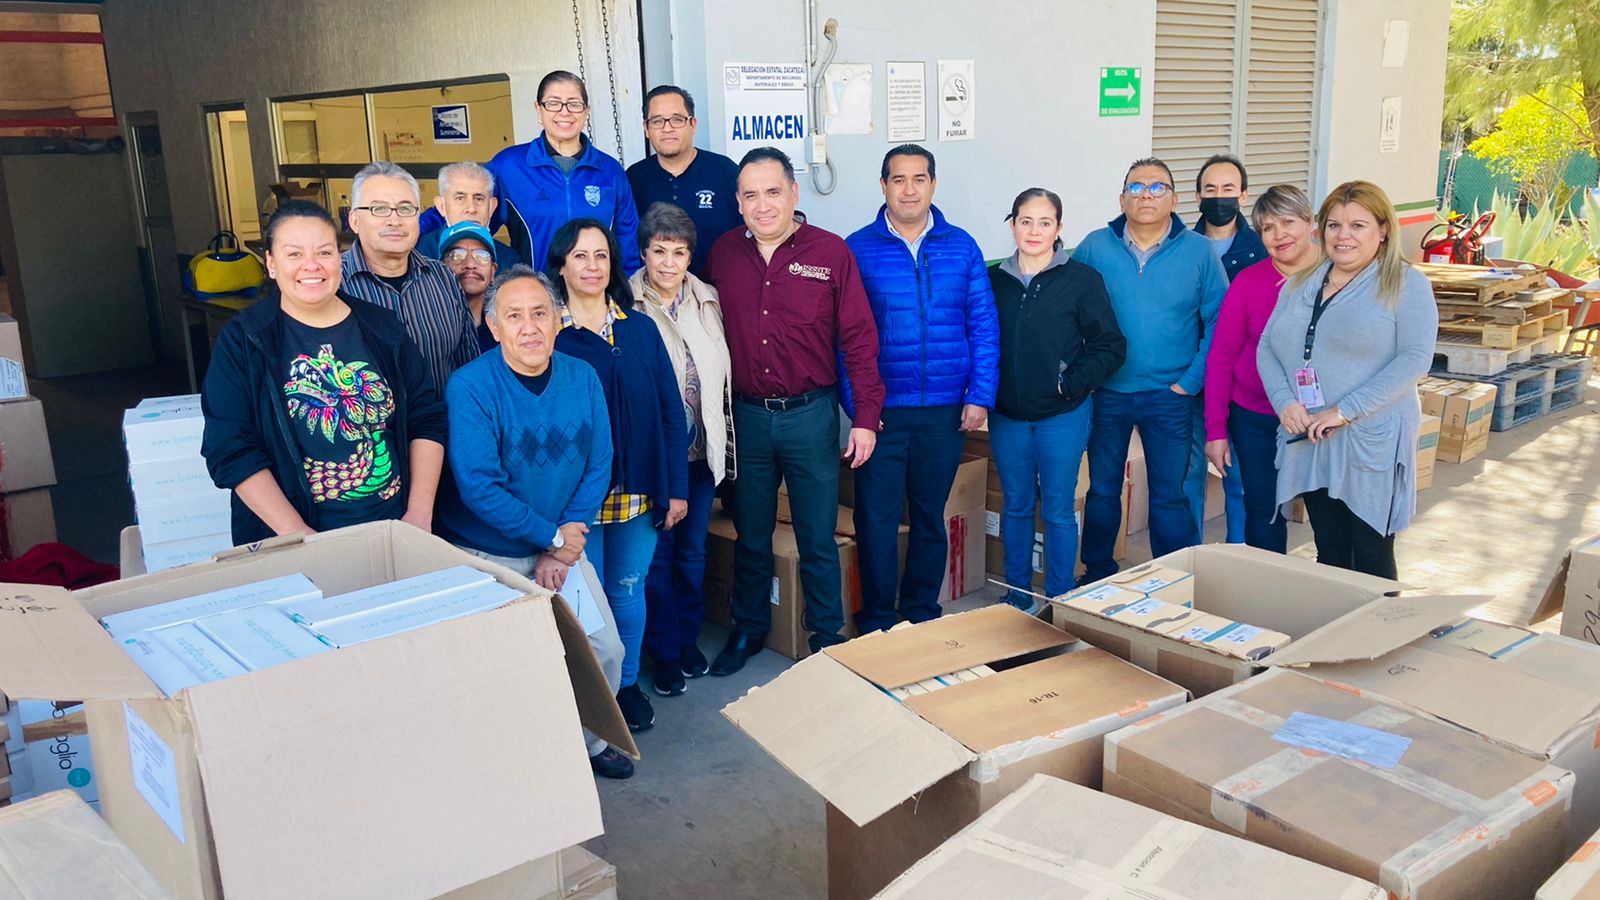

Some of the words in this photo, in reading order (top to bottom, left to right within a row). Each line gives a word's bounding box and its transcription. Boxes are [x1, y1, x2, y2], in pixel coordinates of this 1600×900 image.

[741, 65, 765, 73] DELEGACION
[732, 115, 803, 140] ALMACEN
[946, 129, 967, 137] FUMAR
[699, 193, 713, 205] 22
